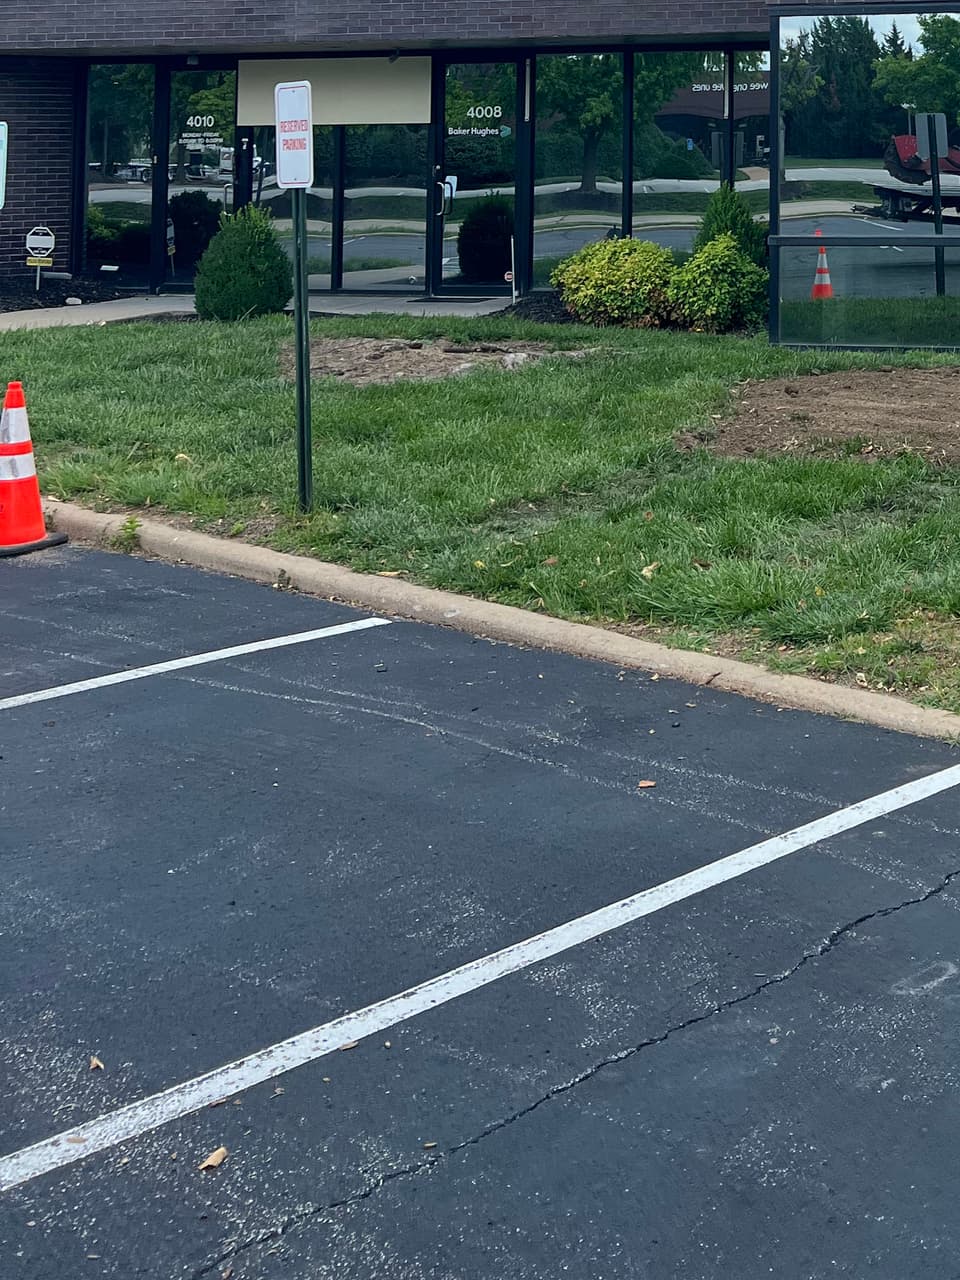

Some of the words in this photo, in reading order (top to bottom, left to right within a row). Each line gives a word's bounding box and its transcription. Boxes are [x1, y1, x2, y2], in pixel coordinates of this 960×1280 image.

[467, 106, 502, 118] 4008
[187, 116, 214, 127] 4010
[280, 120, 308, 132] RESERVED
[448, 127, 470, 135] Baker
[471, 127, 499, 137] Hughes
[282, 138, 306, 150] PARKING
